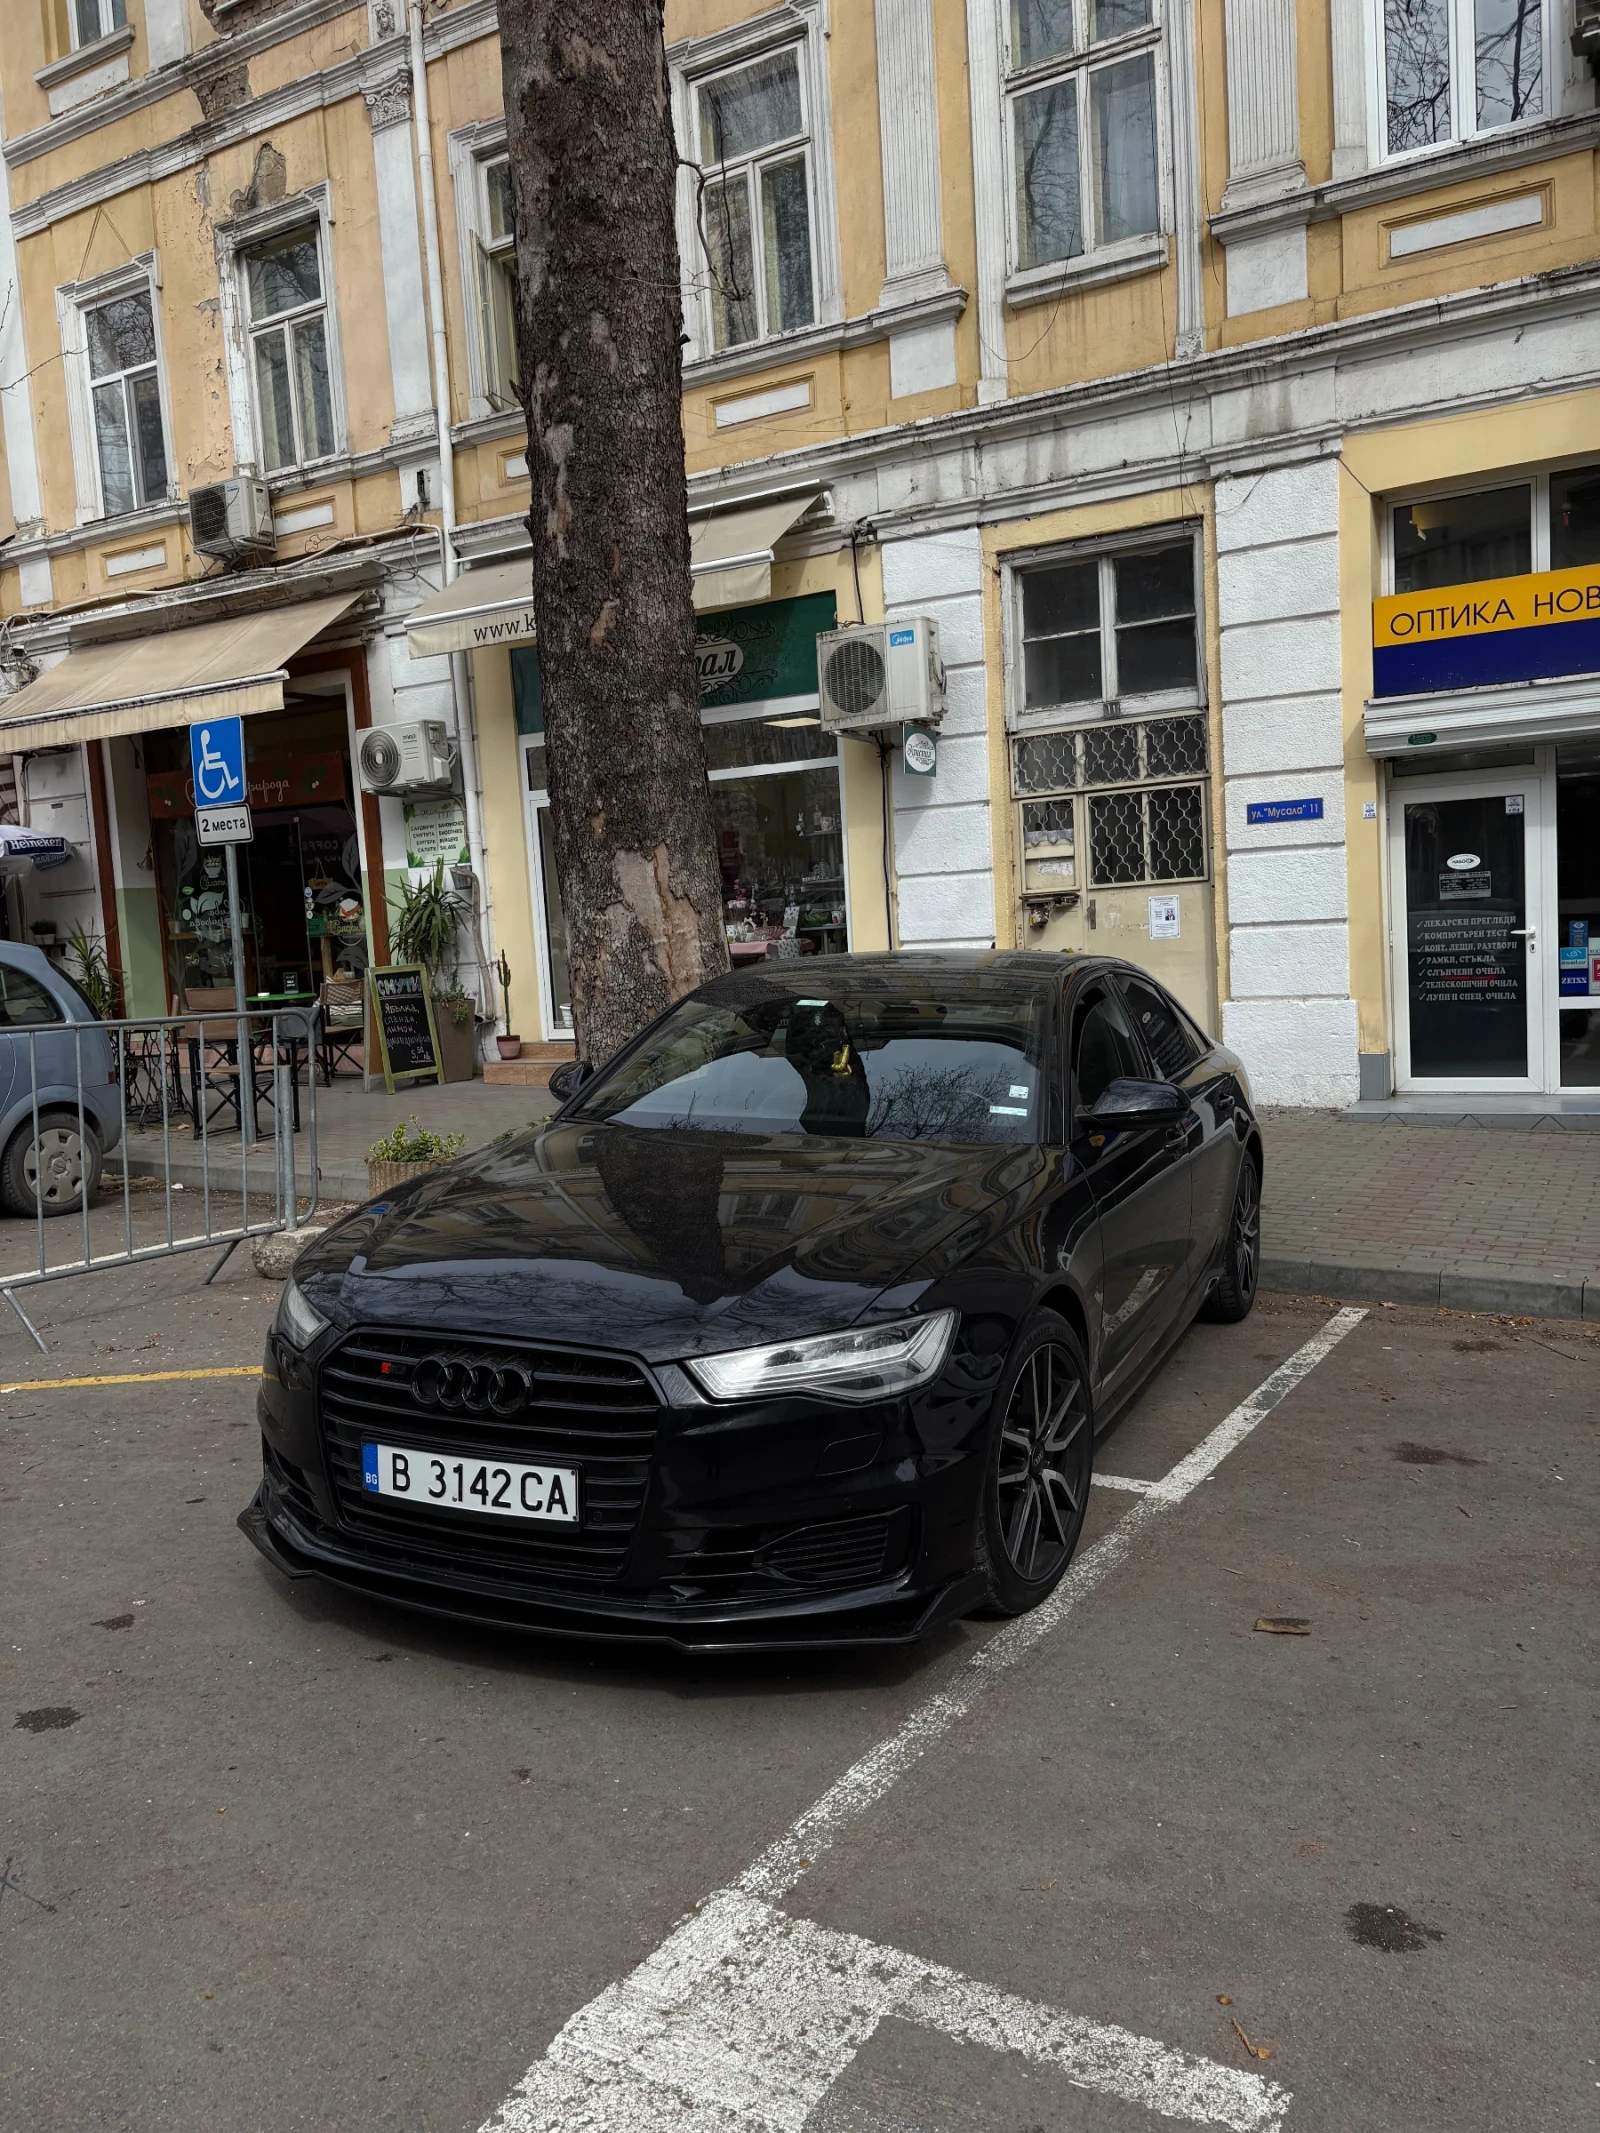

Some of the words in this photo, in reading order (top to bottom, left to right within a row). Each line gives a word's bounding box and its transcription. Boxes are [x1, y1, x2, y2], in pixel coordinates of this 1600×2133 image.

[1390, 599, 1515, 636] ОПТИКА
[1251, 809, 1264, 820] ул.
[1264, 804, 1307, 819] "Мусала"
[1309, 803, 1319, 813] 11
[201, 818, 211, 833] 2
[212, 817, 246, 832] места
[10, 838, 62, 850] Heineken
[1423, 918, 1469, 928] ЛЕКАРСКИ
[1470, 915, 1516, 925] ПРЕГЛЕДИ
[1424, 930, 1484, 940] КОМПЮТЪРЕН
[1486, 929, 1507, 937] ТЕСТ
[1477, 941, 1517, 950] РАЗТВОРИ
[1459, 955, 1496, 963] СТЪКЛА
[1427, 968, 1473, 976] СЛЪНЧЕВИ
[1475, 966, 1506, 975] ОЧИЛА
[377, 976, 422, 996] СМУТИ
[1426, 980, 1488, 989] ТЕЛЕСКОПИЧНИ
[1489, 979, 1518, 987] ОЧИЛА
[1426, 993, 1452, 1001] ЛУПИ
[1485, 992, 1516, 1000] ОЧИЛА
[365, 1472, 378, 1485] BG
[392, 1453, 410, 1492] B
